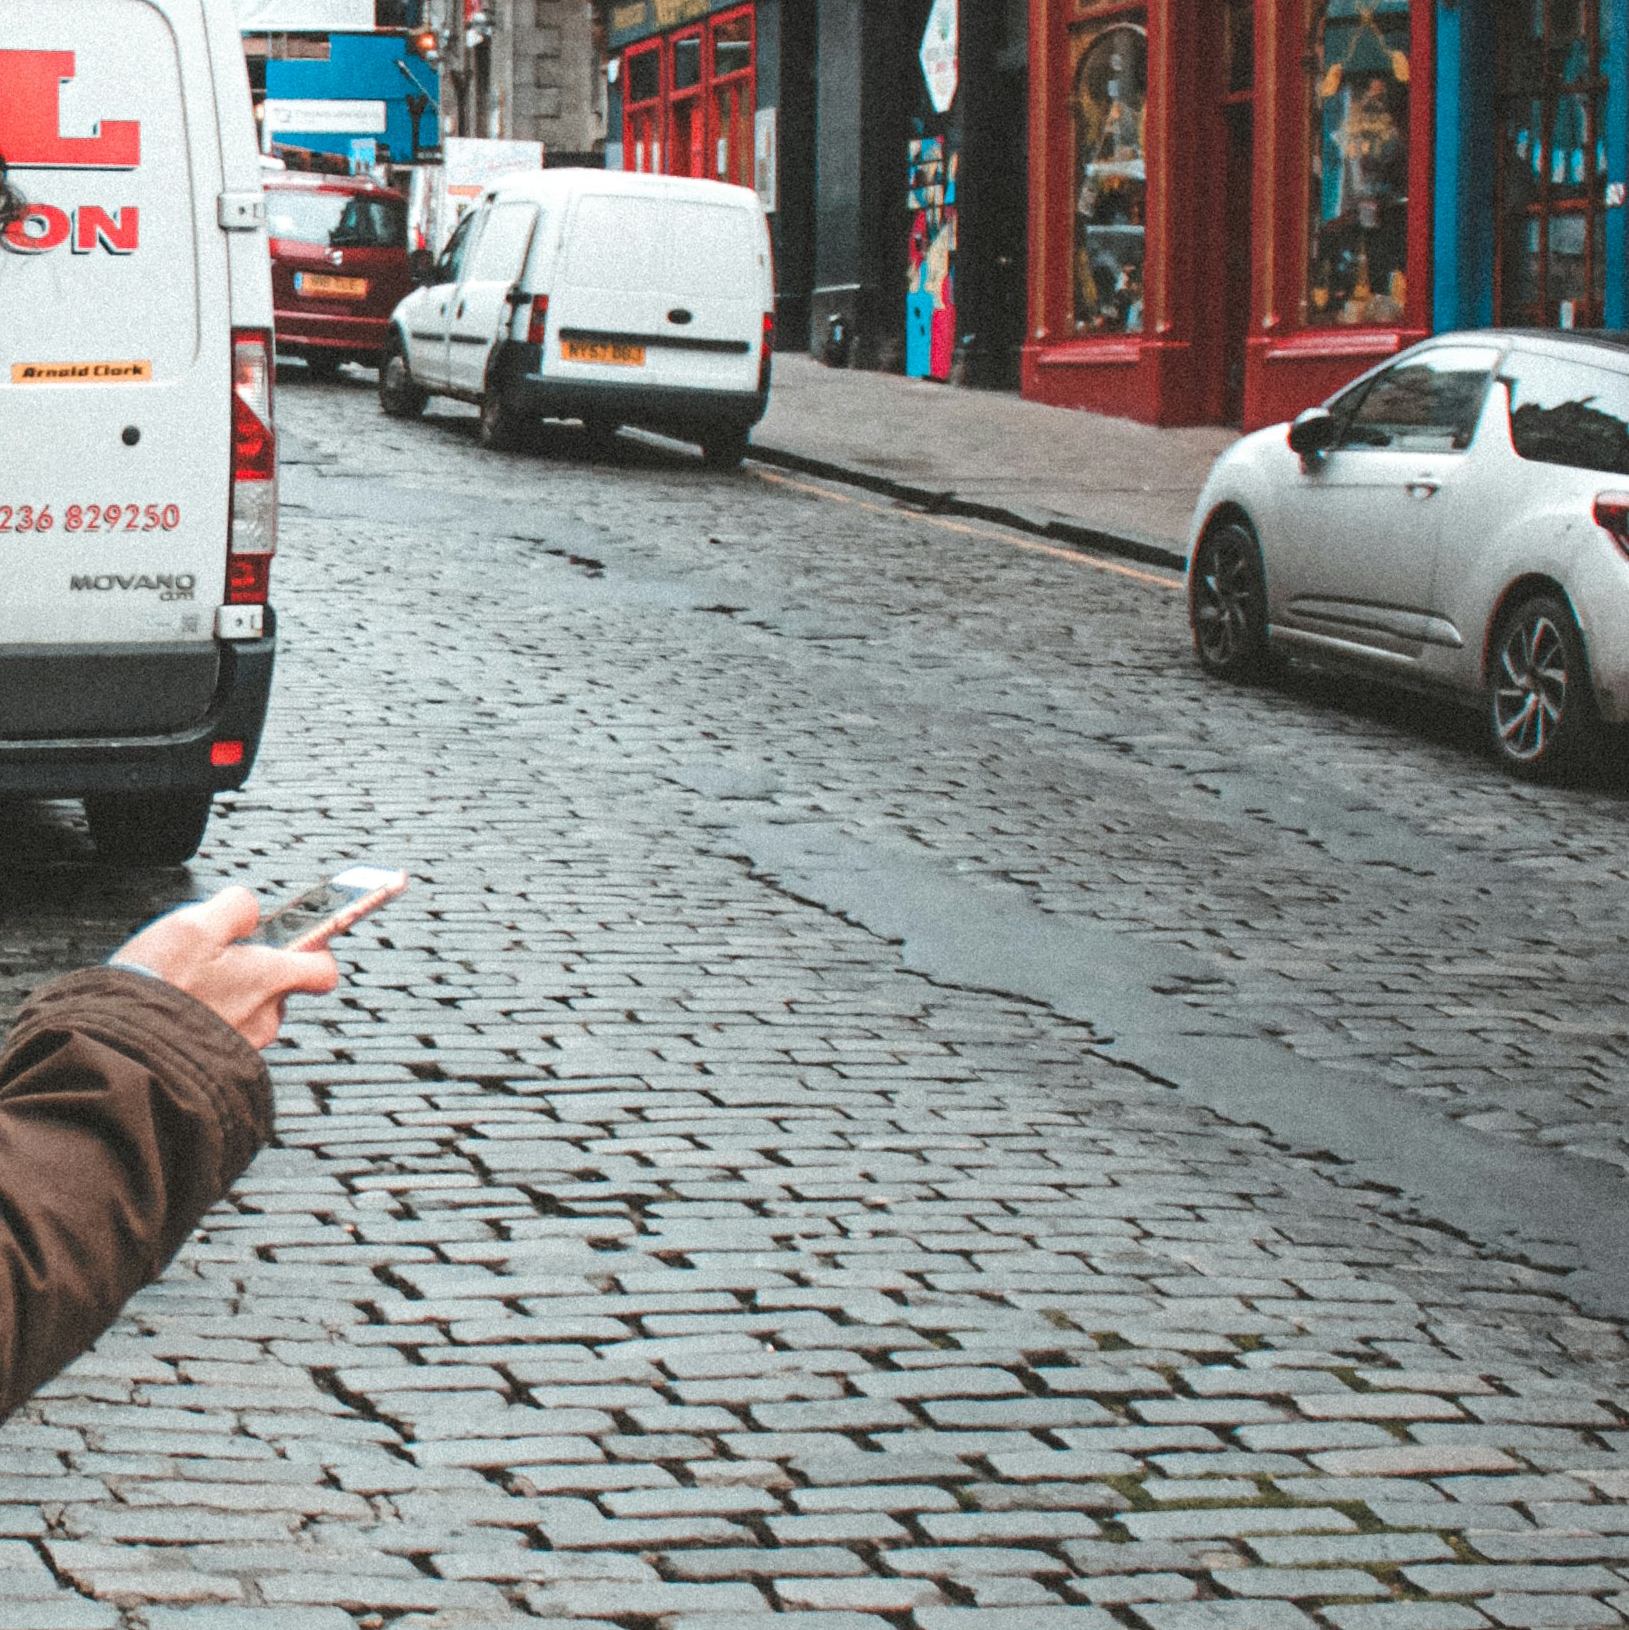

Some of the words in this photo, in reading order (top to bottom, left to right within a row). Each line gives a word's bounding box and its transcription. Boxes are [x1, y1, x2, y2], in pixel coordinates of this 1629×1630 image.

[22, 365, 89, 379] Arnold
[93, 363, 144, 378] Clark
[64, 503, 181, 532] 829250
[70, 573, 196, 591] MOVANO
